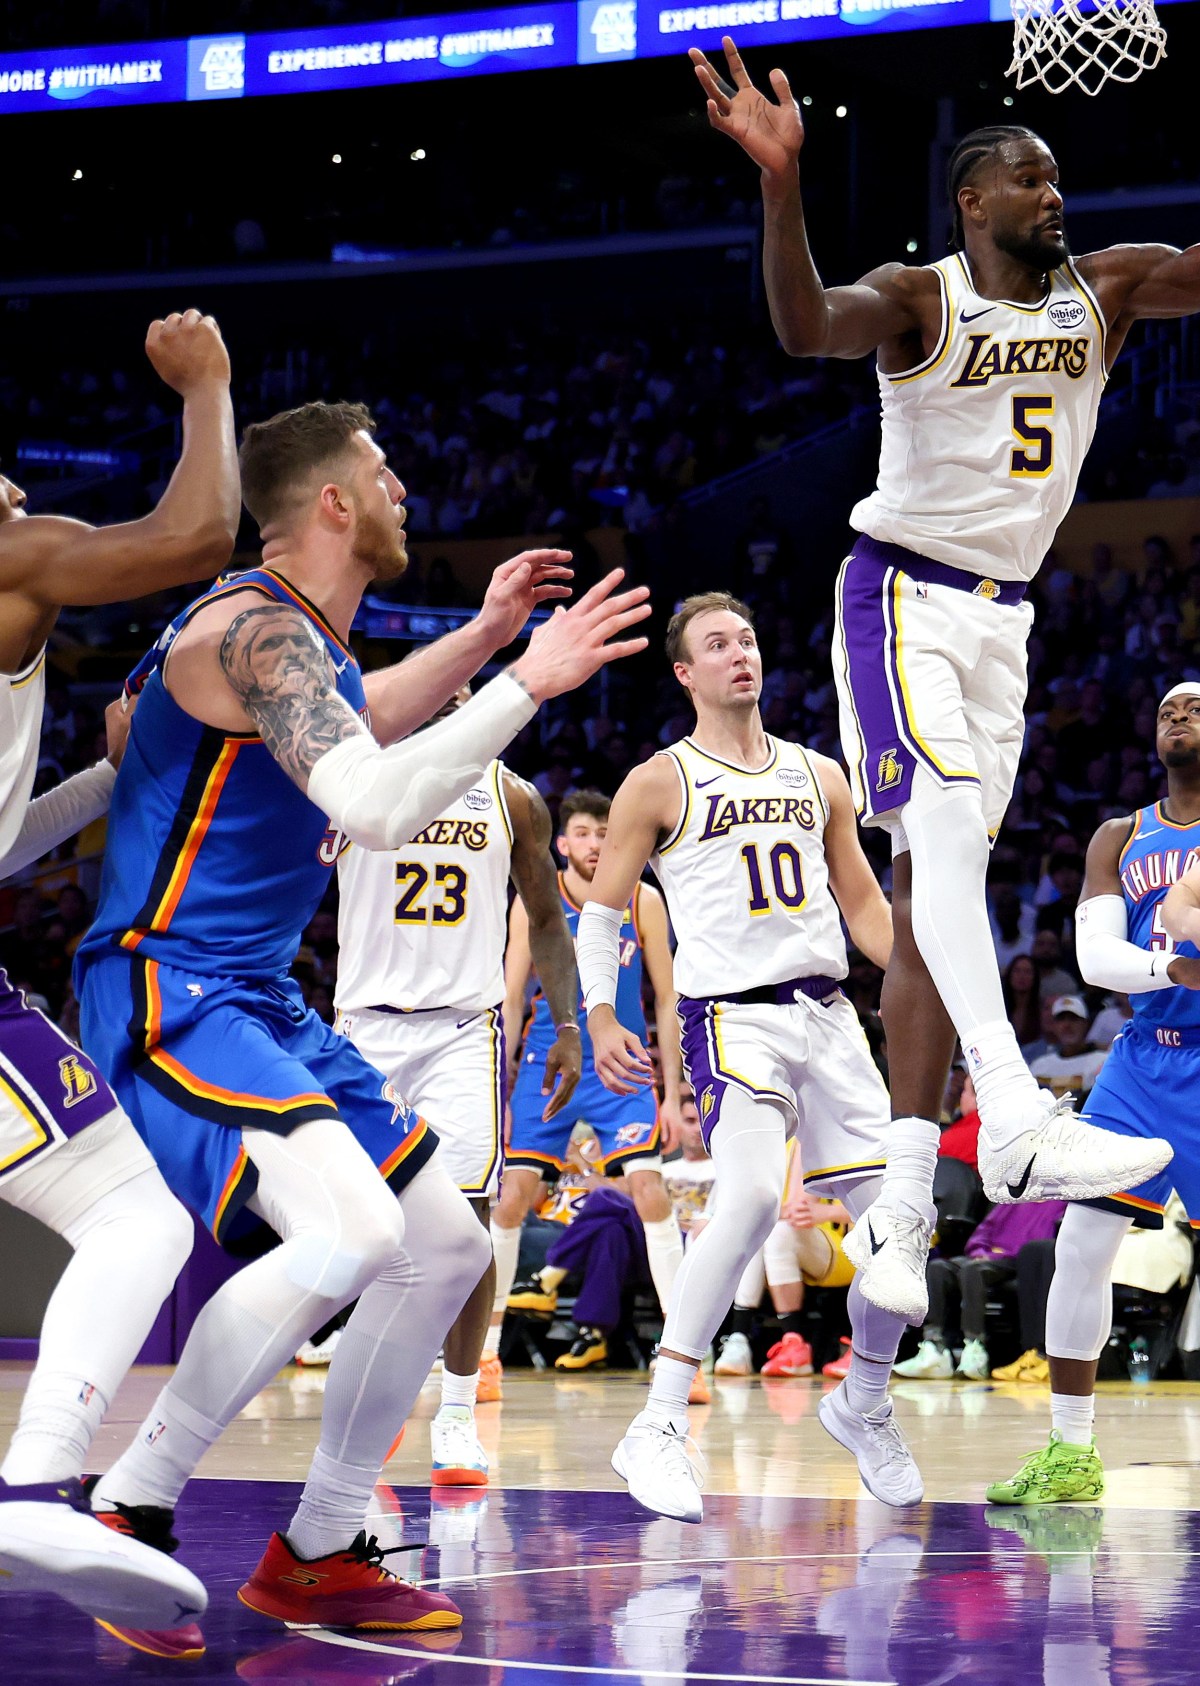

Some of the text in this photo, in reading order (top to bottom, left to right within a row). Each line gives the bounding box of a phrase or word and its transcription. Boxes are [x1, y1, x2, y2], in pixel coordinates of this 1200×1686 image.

[658, 1, 778, 33] EXPERIENCE
[268, 24, 555, 74] EXPERIENCE MORE #WITHAMEX
[48, 60, 163, 89] #WITHAMEX
[1050, 307, 1083, 319] bibigo
[949, 333, 1090, 389] LAKERS
[1009, 393, 1056, 478] 5
[466, 794, 491, 805] bibigo
[698, 793, 816, 843] LAKERS
[408, 819, 489, 852] KERS
[394, 861, 468, 927] 23
[741, 840, 808, 917] 10
[1121, 848, 1200, 904] THUND
[1156, 1027, 1182, 1047] OKC
